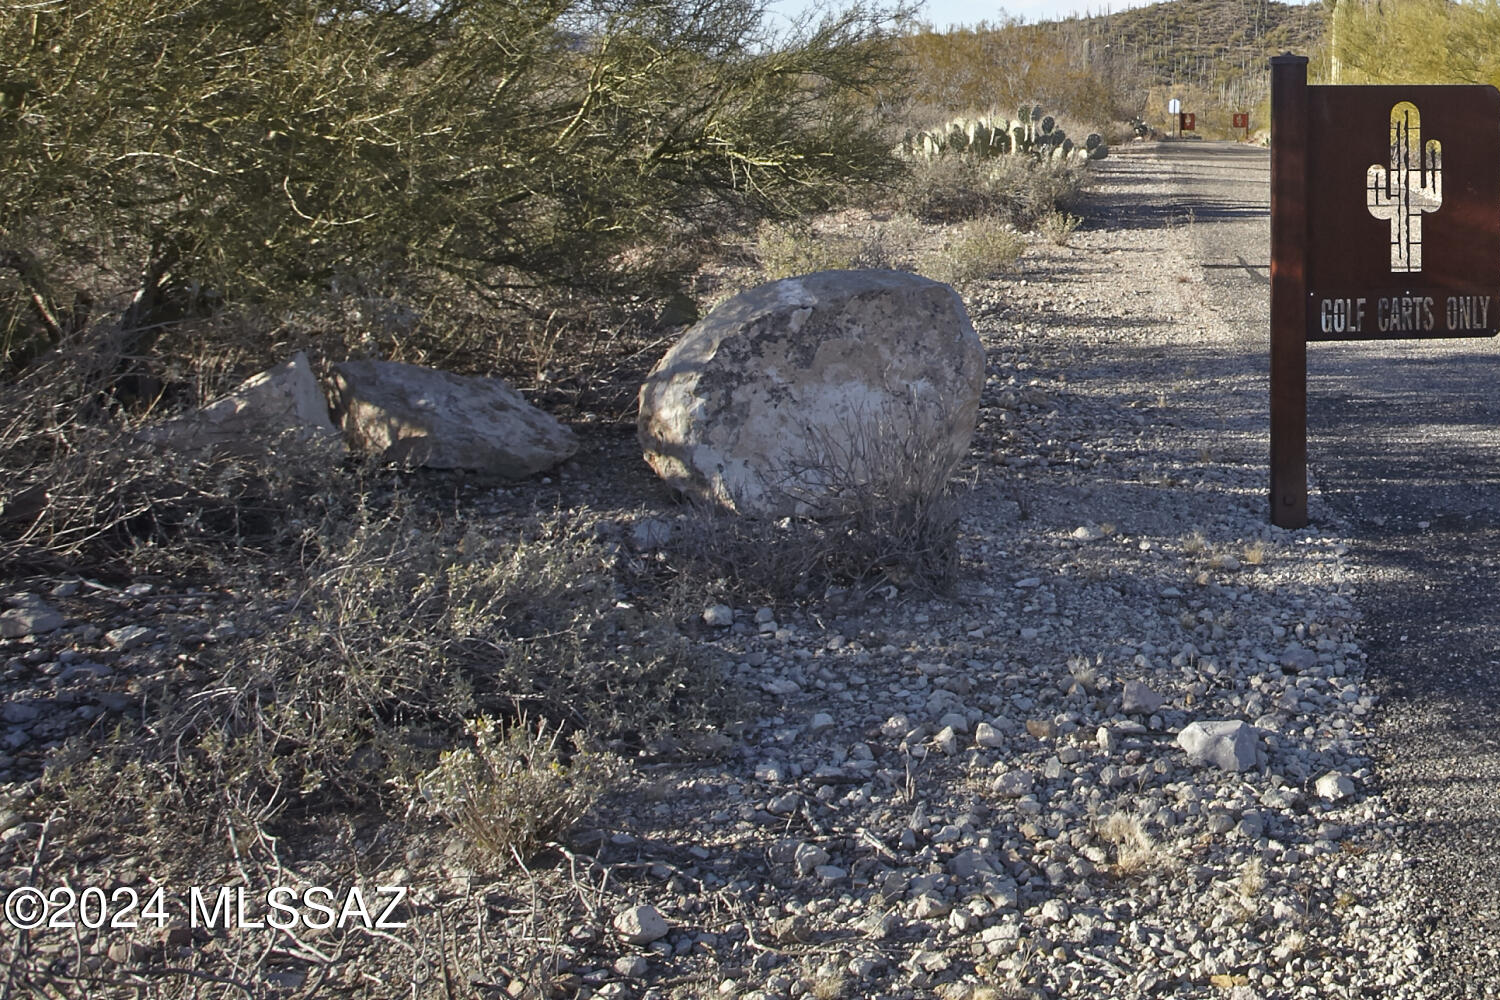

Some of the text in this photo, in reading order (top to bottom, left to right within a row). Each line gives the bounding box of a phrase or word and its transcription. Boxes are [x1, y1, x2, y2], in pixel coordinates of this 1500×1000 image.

[1321, 296, 1490, 333] GOLF CARTS ONLY
